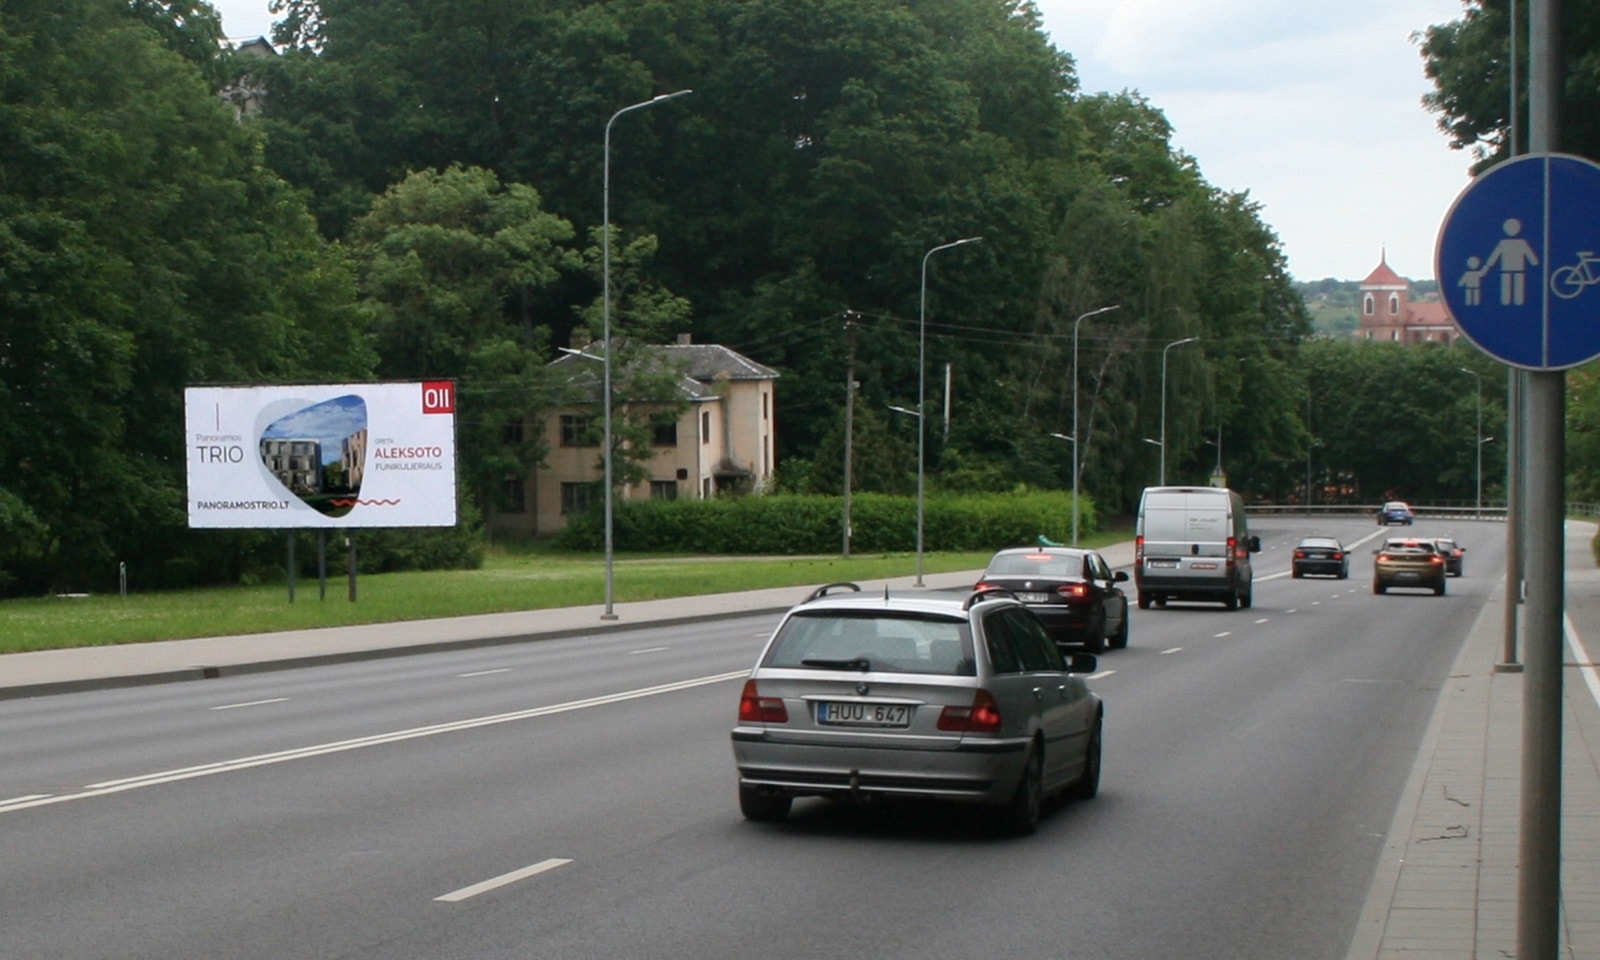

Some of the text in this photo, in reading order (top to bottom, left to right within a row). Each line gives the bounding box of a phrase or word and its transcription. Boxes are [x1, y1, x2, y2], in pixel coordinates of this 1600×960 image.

[196, 445, 244, 463] TRIO
[374, 447, 442, 459] ALEKSOTO
[197, 501, 289, 510] PANORAMOSTRIO.LT
[828, 705, 906, 722] HUU 647
